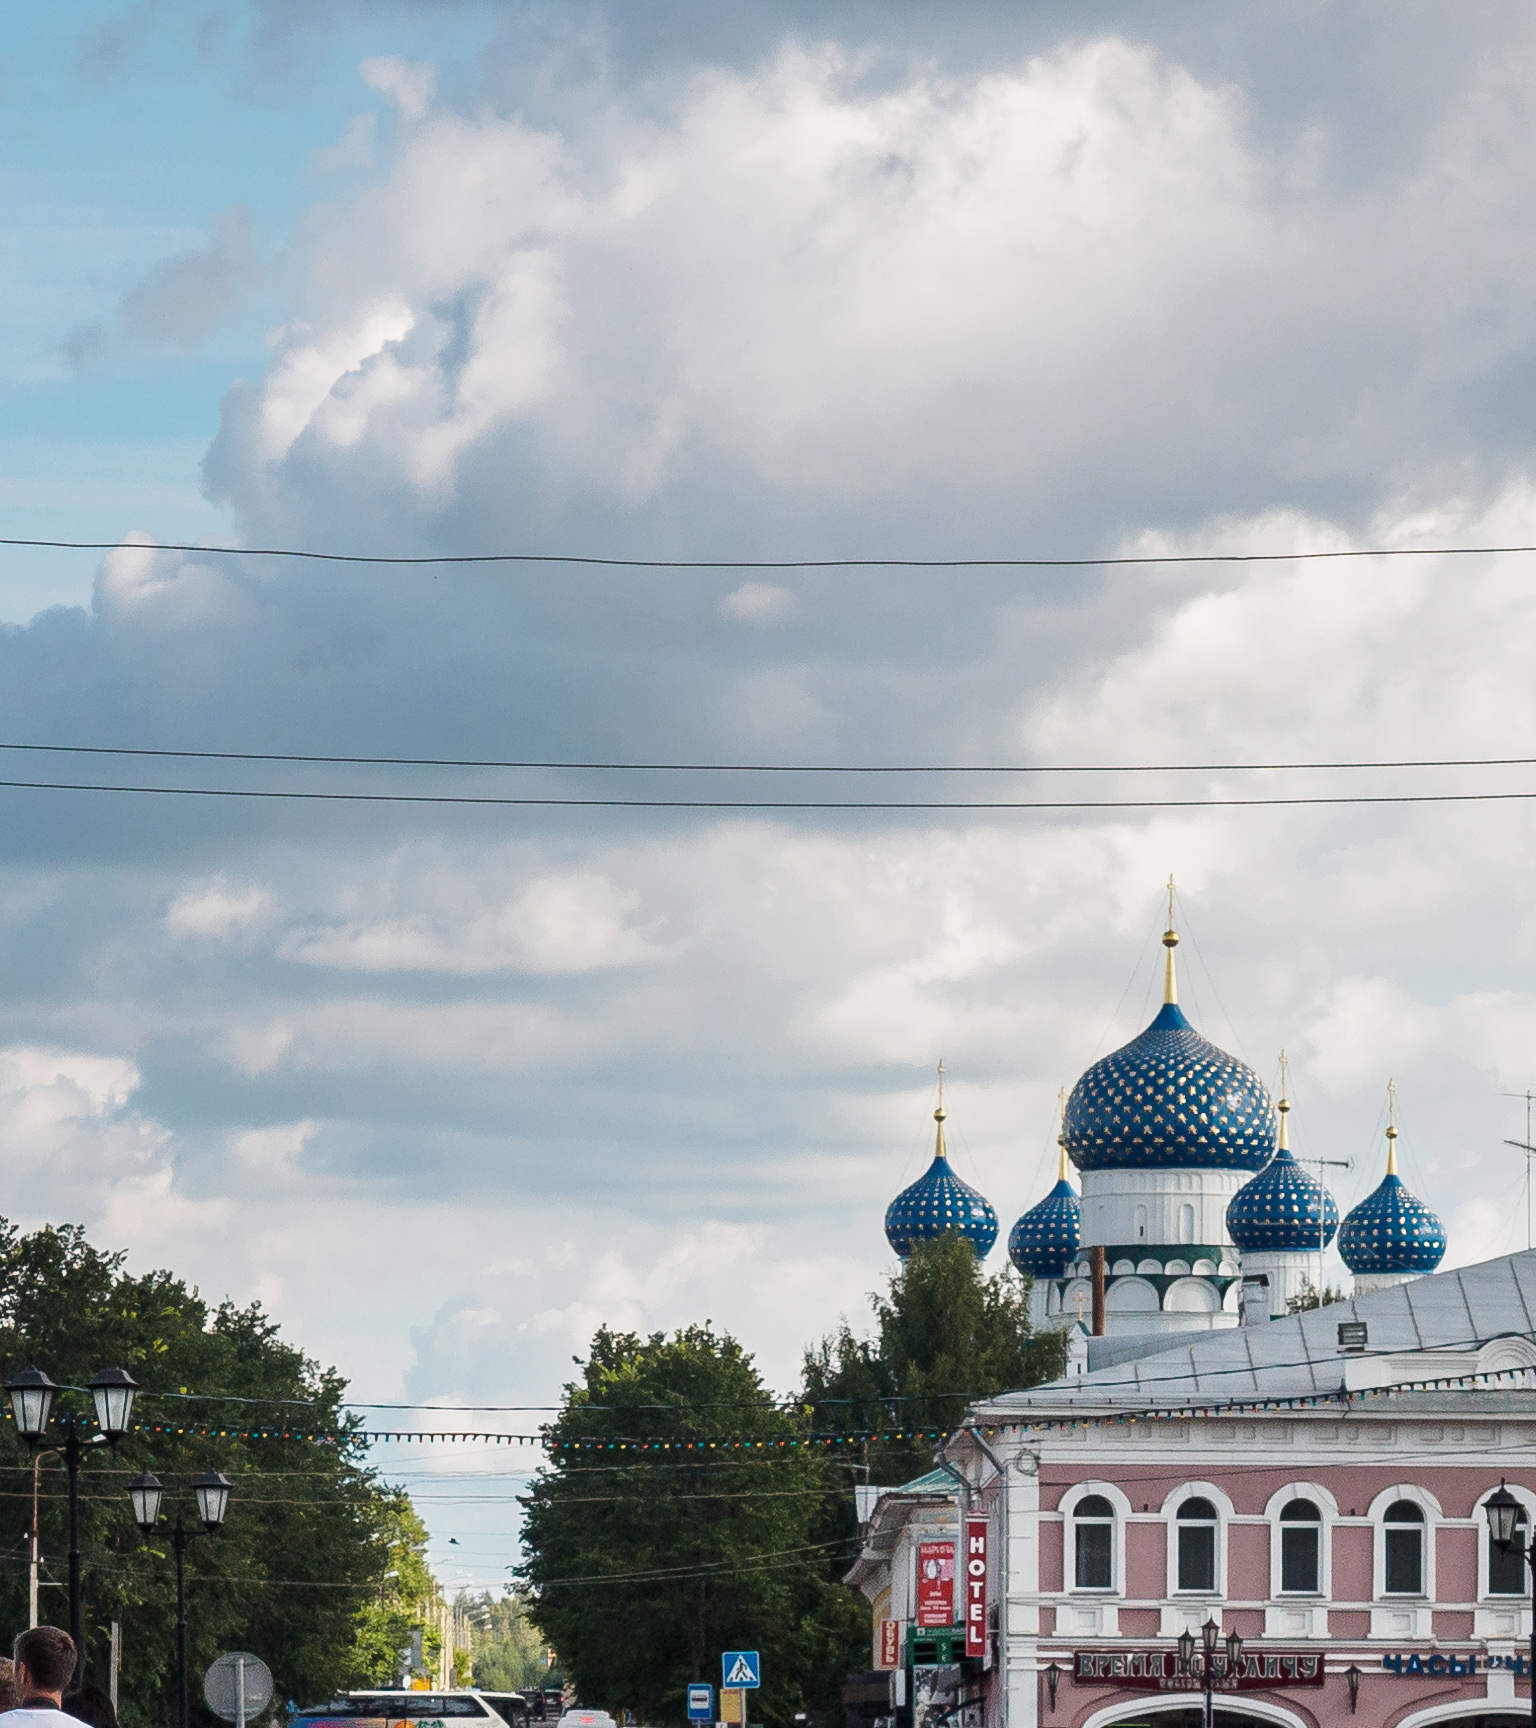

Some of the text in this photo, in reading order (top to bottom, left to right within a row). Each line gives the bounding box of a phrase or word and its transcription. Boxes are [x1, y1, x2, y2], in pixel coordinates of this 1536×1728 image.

[968, 1536, 986, 1643] HOTEL
[1077, 1652, 1166, 1678] ВРЕМЯ
[1382, 1654, 1476, 1676] ЧАСЫ
